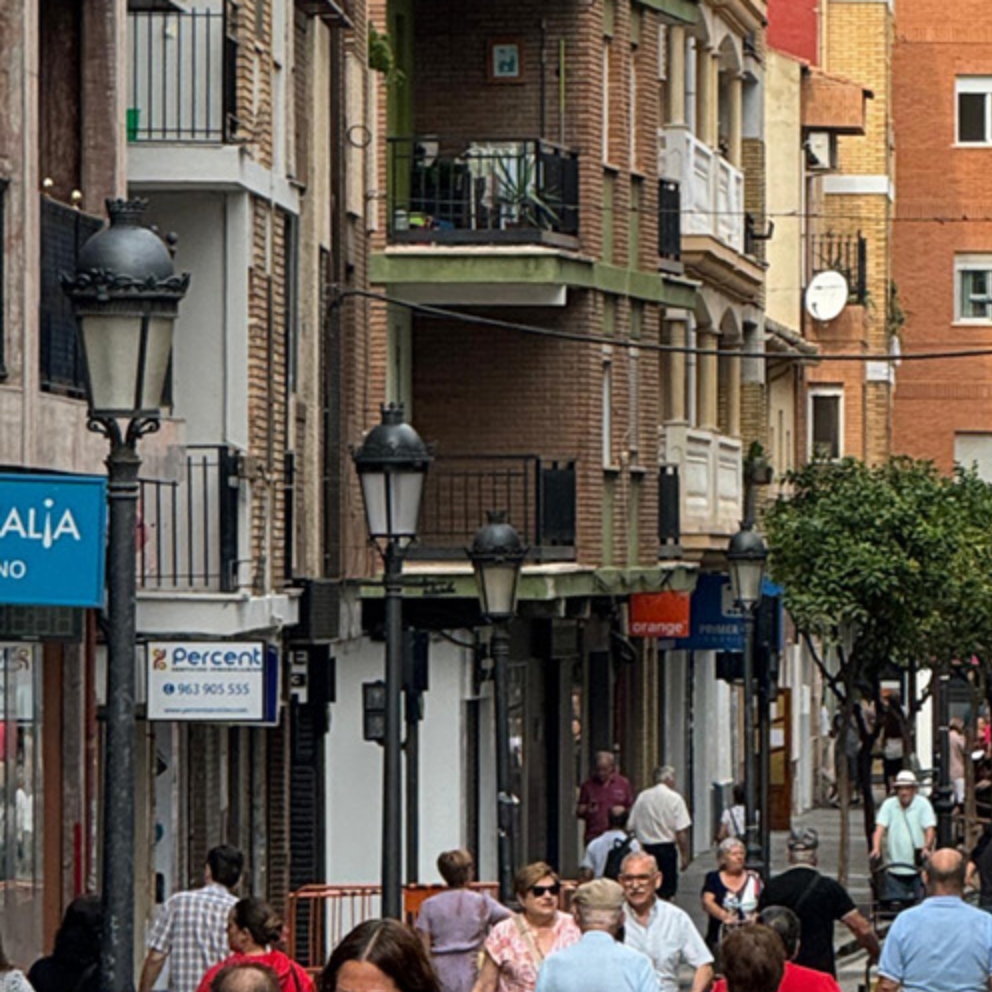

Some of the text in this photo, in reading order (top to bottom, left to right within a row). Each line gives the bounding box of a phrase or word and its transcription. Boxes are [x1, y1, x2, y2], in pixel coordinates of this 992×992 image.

[632, 622, 684, 636] orange
[172, 647, 262, 665] Percent
[178, 683, 249, 695] 963 905 555
